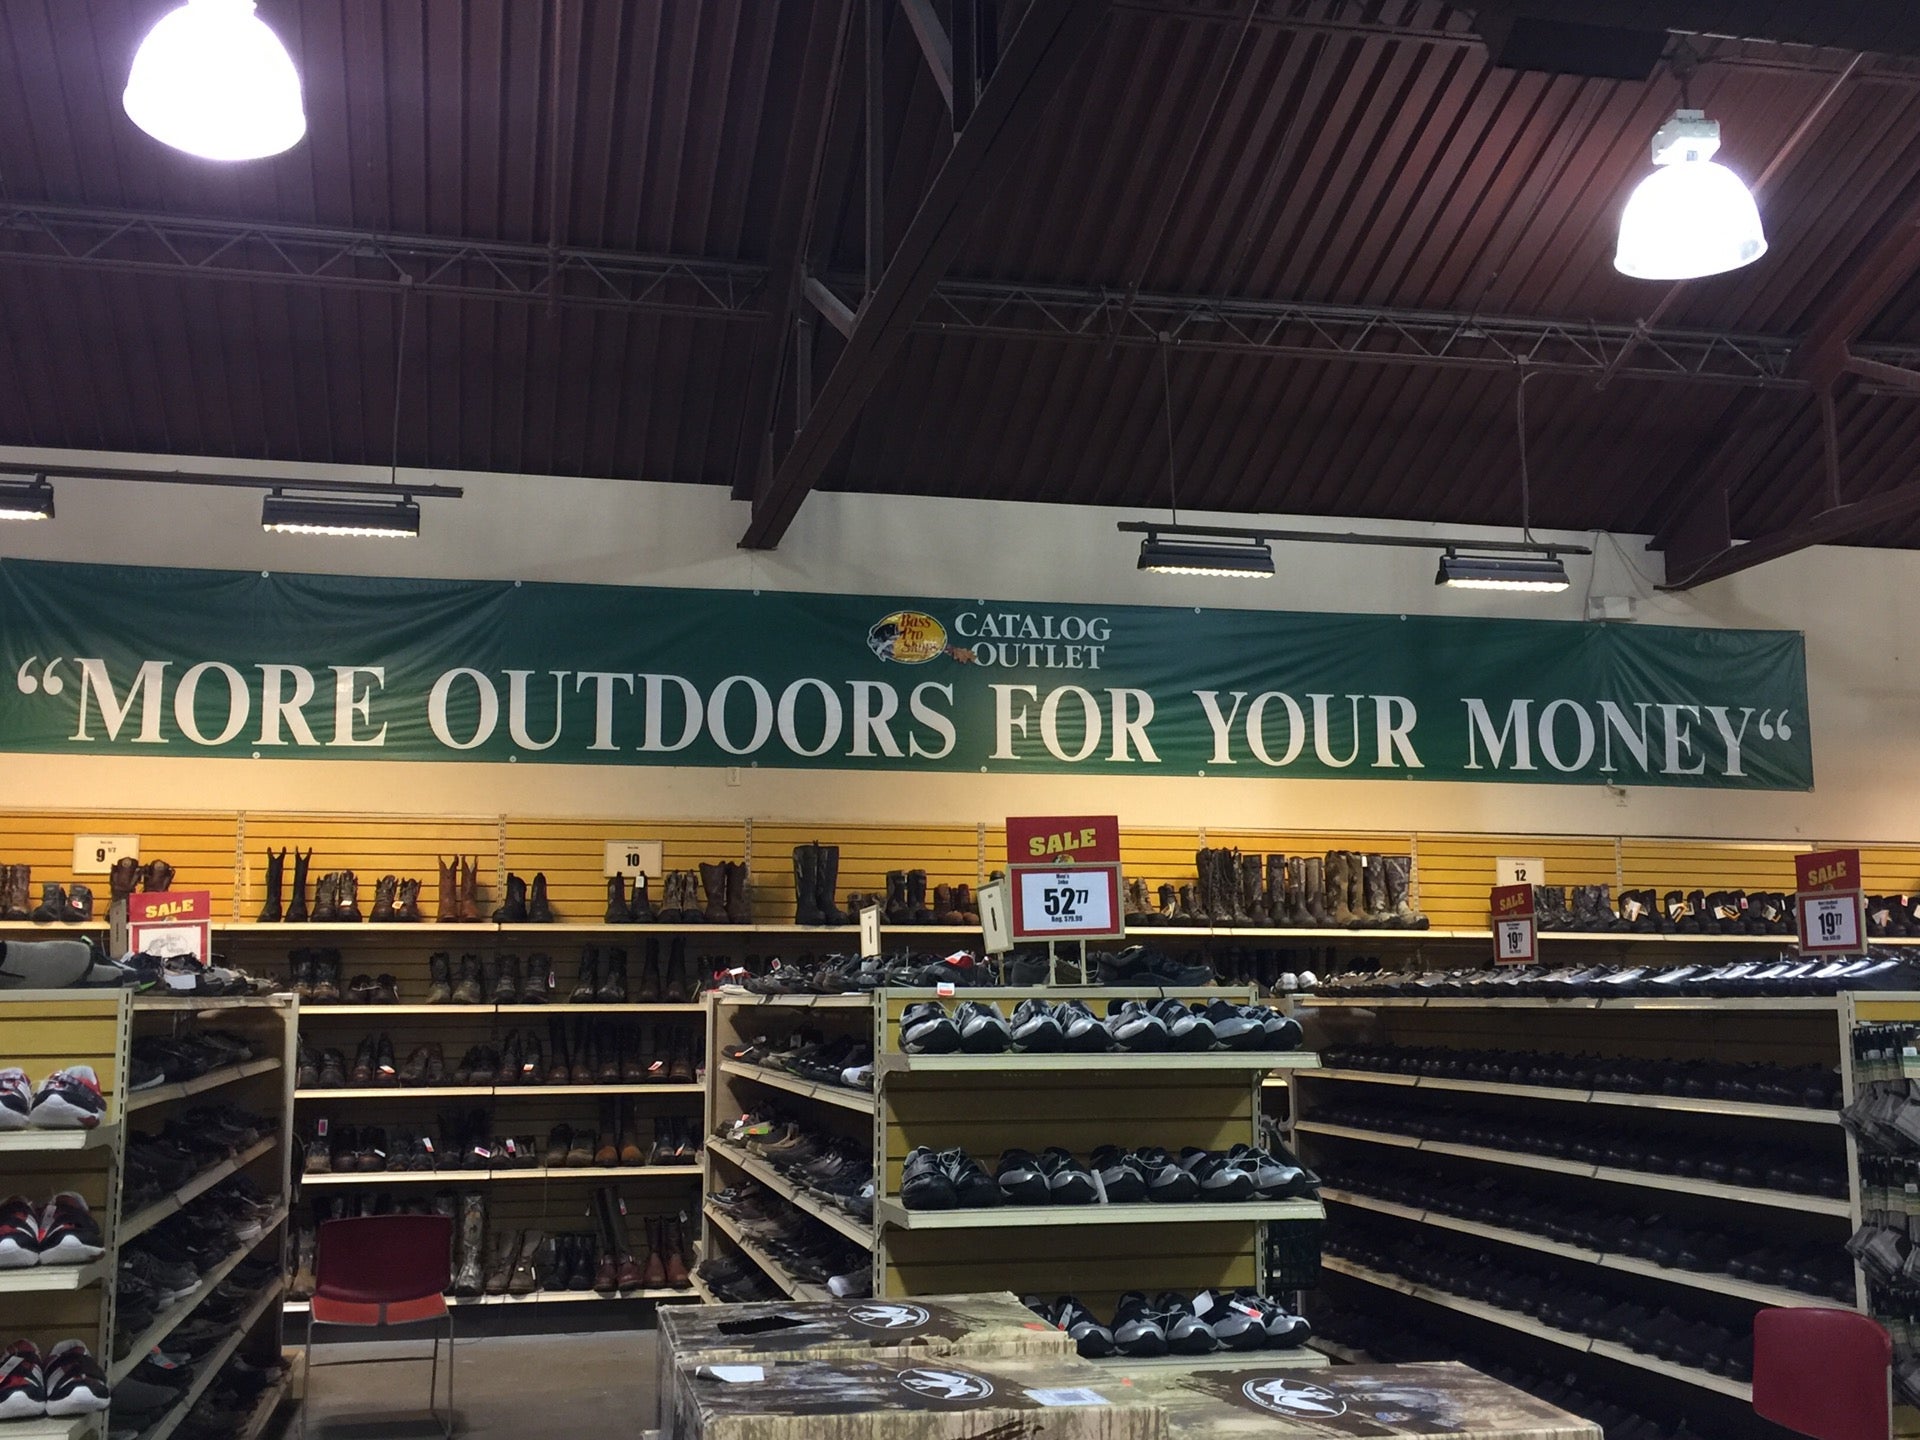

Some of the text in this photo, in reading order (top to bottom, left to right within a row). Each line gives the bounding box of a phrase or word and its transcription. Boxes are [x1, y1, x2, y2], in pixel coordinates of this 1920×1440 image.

[900, 613, 931, 628] Bass
[954, 612, 1112, 641] CATALOG
[901, 627, 924, 640] Pro
[971, 641, 1105, 670] OUTLET
[428, 666, 957, 760] OUTDOORS
[987, 683, 1162, 763] FOR
[1192, 689, 1425, 769] YOUR
[1028, 828, 1097, 857] SALE
[96, 848, 106, 863] 9
[625, 853, 640, 867] 10
[1514, 869, 1527, 882] 12
[1808, 861, 1847, 886] SALE
[145, 898, 194, 919] SALE
[1500, 892, 1525, 912] SALE
